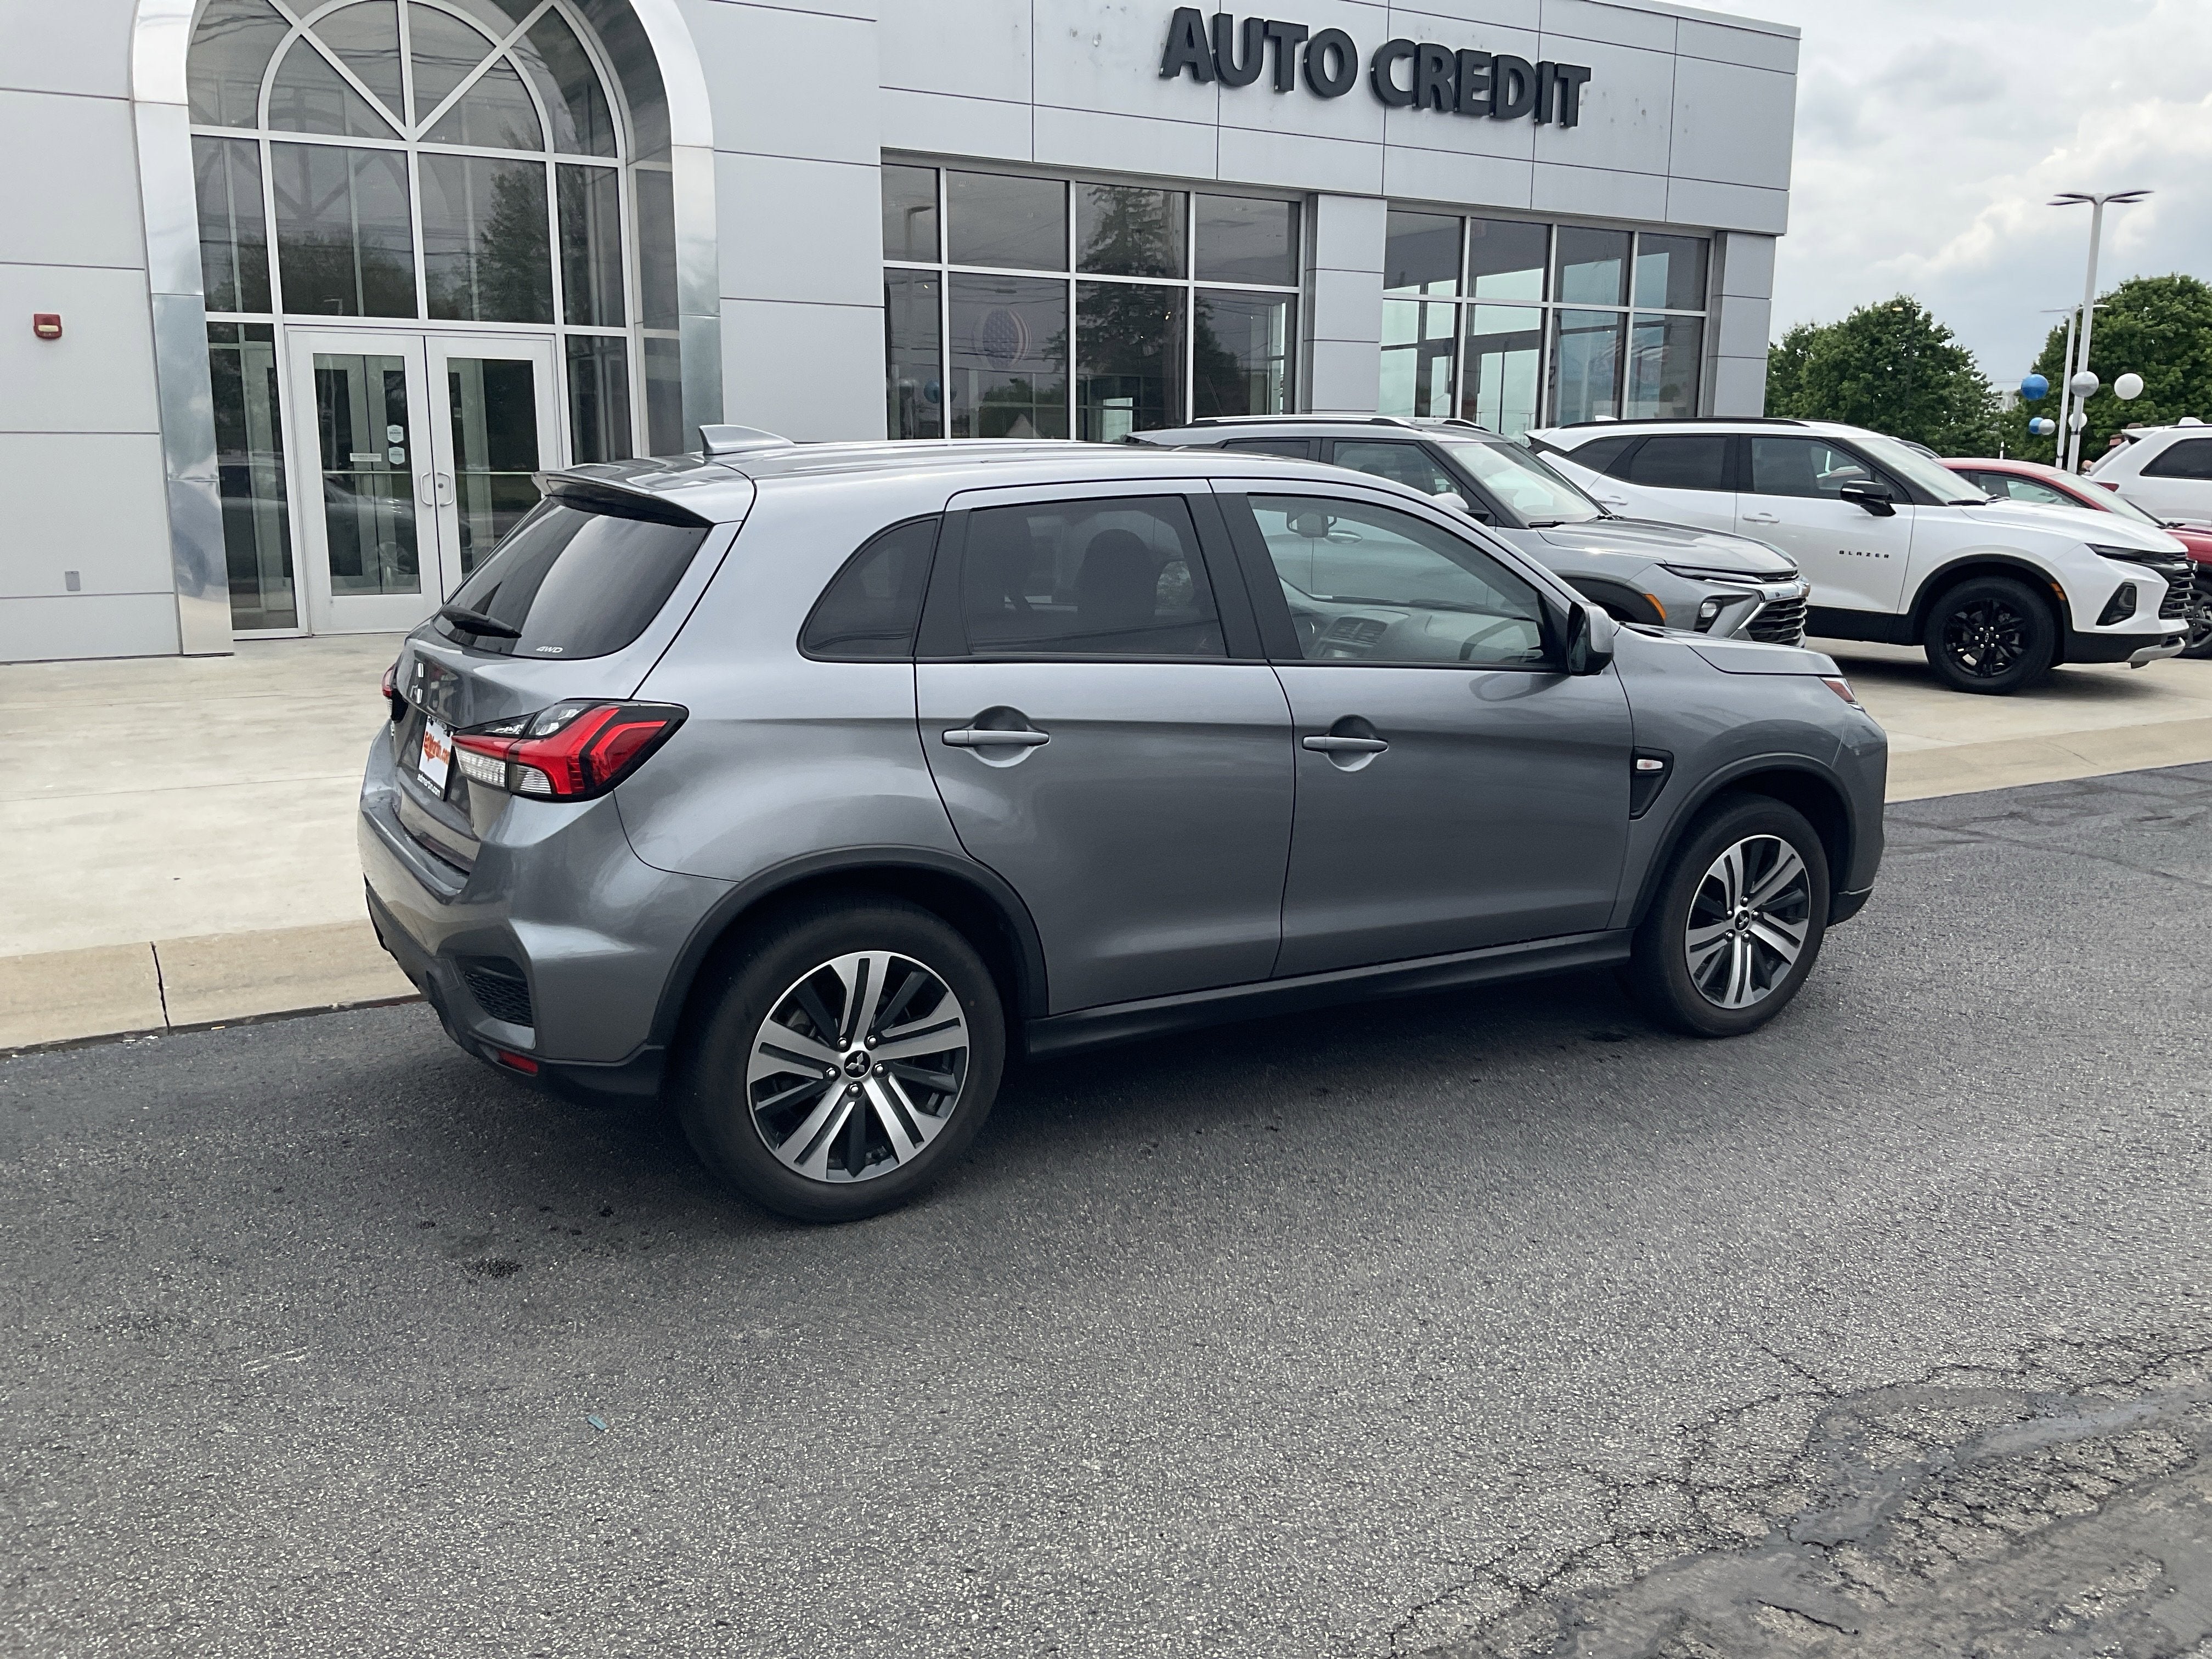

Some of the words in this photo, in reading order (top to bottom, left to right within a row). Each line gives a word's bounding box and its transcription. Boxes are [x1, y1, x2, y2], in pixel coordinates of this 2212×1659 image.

[1159, 6, 1358, 99] AUTO
[1370, 38, 1592, 127] CREDIT
[1839, 550, 1889, 558] BLAZER
